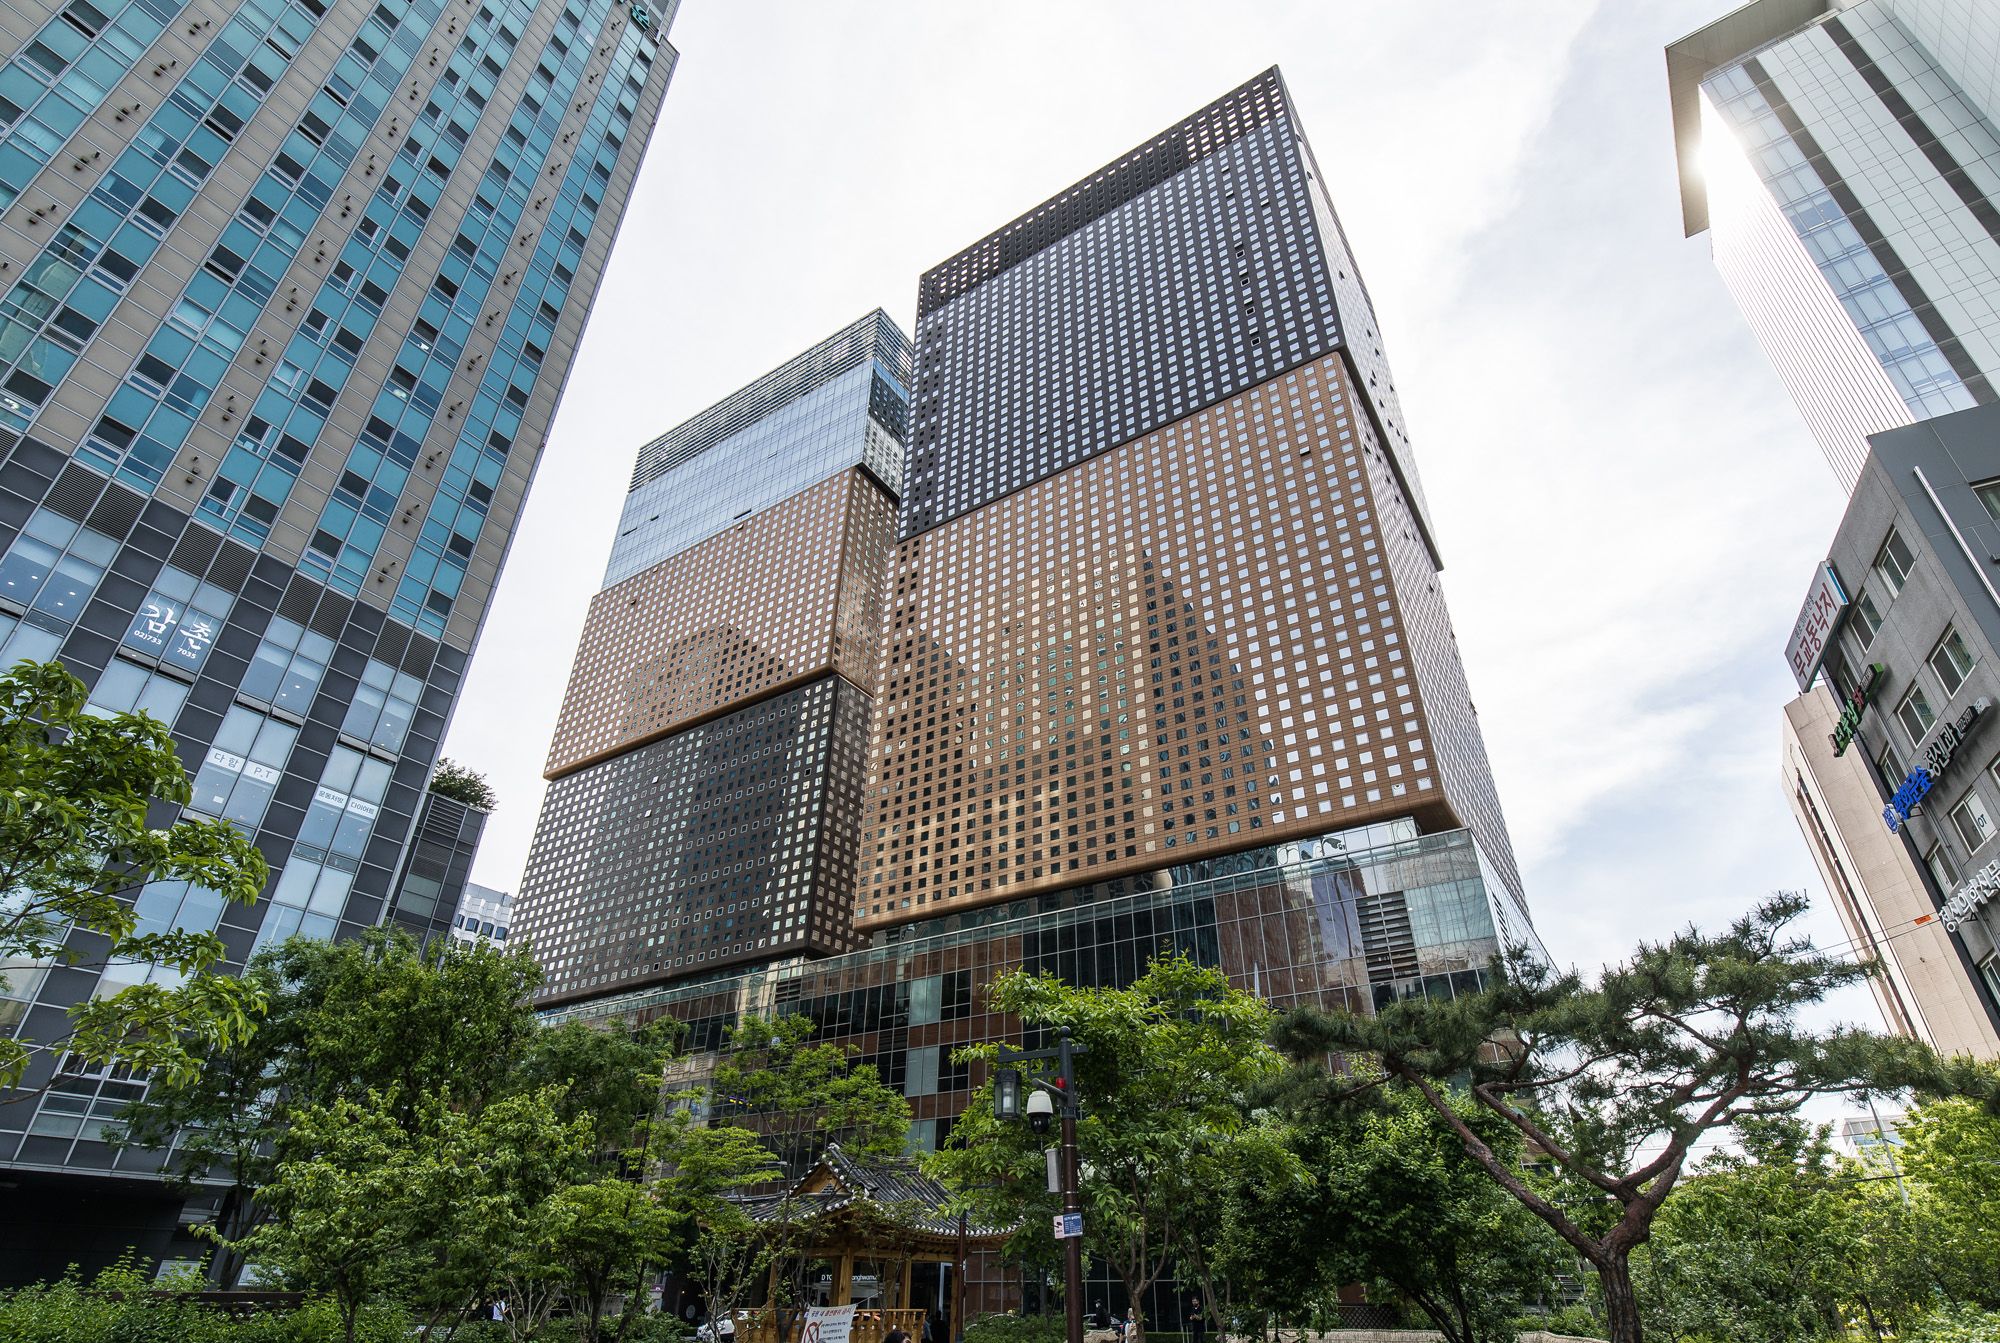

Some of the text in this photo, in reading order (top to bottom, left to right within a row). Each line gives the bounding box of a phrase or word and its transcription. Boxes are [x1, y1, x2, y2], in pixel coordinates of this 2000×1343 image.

[134, 629, 197, 659] 02)733 7035
[1793, 582, 1838, 680] 무교동낙지
[1923, 723, 1959, 776] 정신과
[253, 766, 273, 779] P.T
[350, 801, 375, 815] 다이어트
